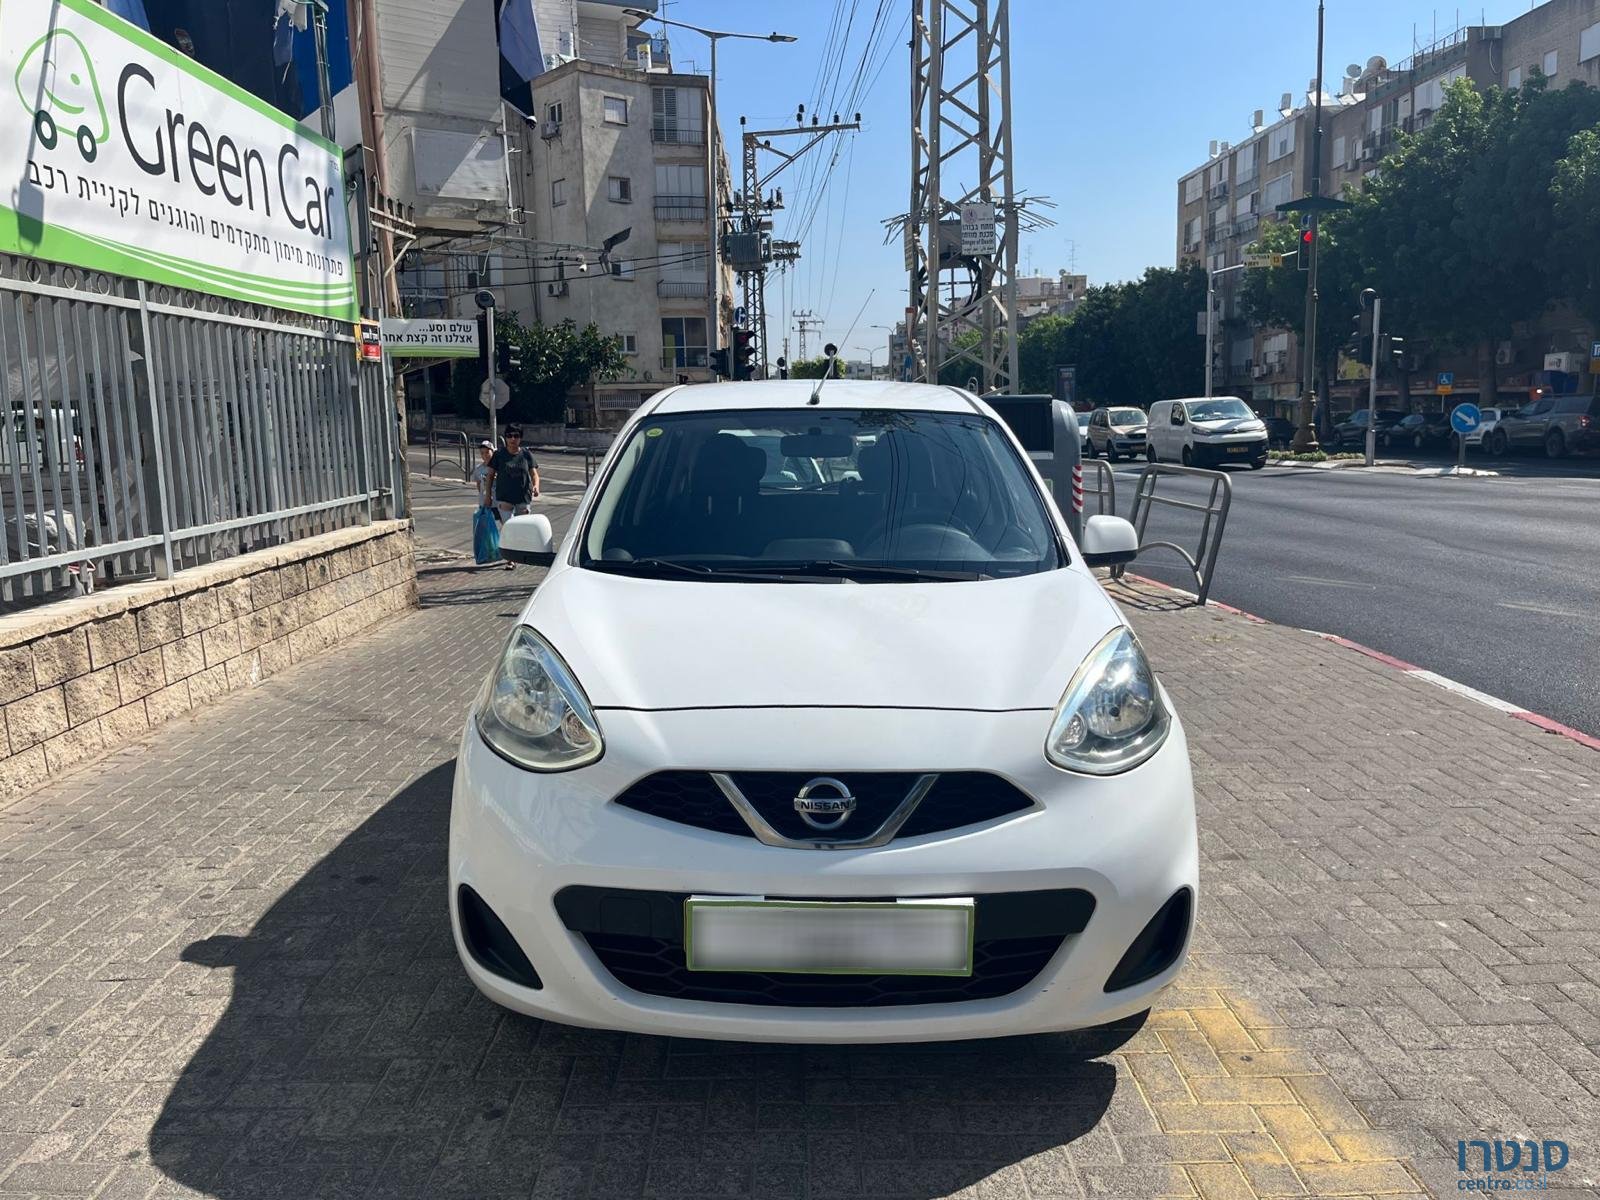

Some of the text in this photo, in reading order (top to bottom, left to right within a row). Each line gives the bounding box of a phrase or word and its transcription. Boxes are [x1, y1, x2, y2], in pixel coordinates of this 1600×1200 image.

[117, 62, 334, 240] Green Car
[28, 159, 344, 276] פתרונות מימון מתקדמים והוגנים לקניית רכב
[449, 322, 472, 333] שלם
[382, 333, 403, 342] אחר
[406, 333, 428, 344] קצת
[431, 333, 441, 342] זה
[445, 333, 473, 343] אצלנו
[800, 801, 850, 810] NISSAN
